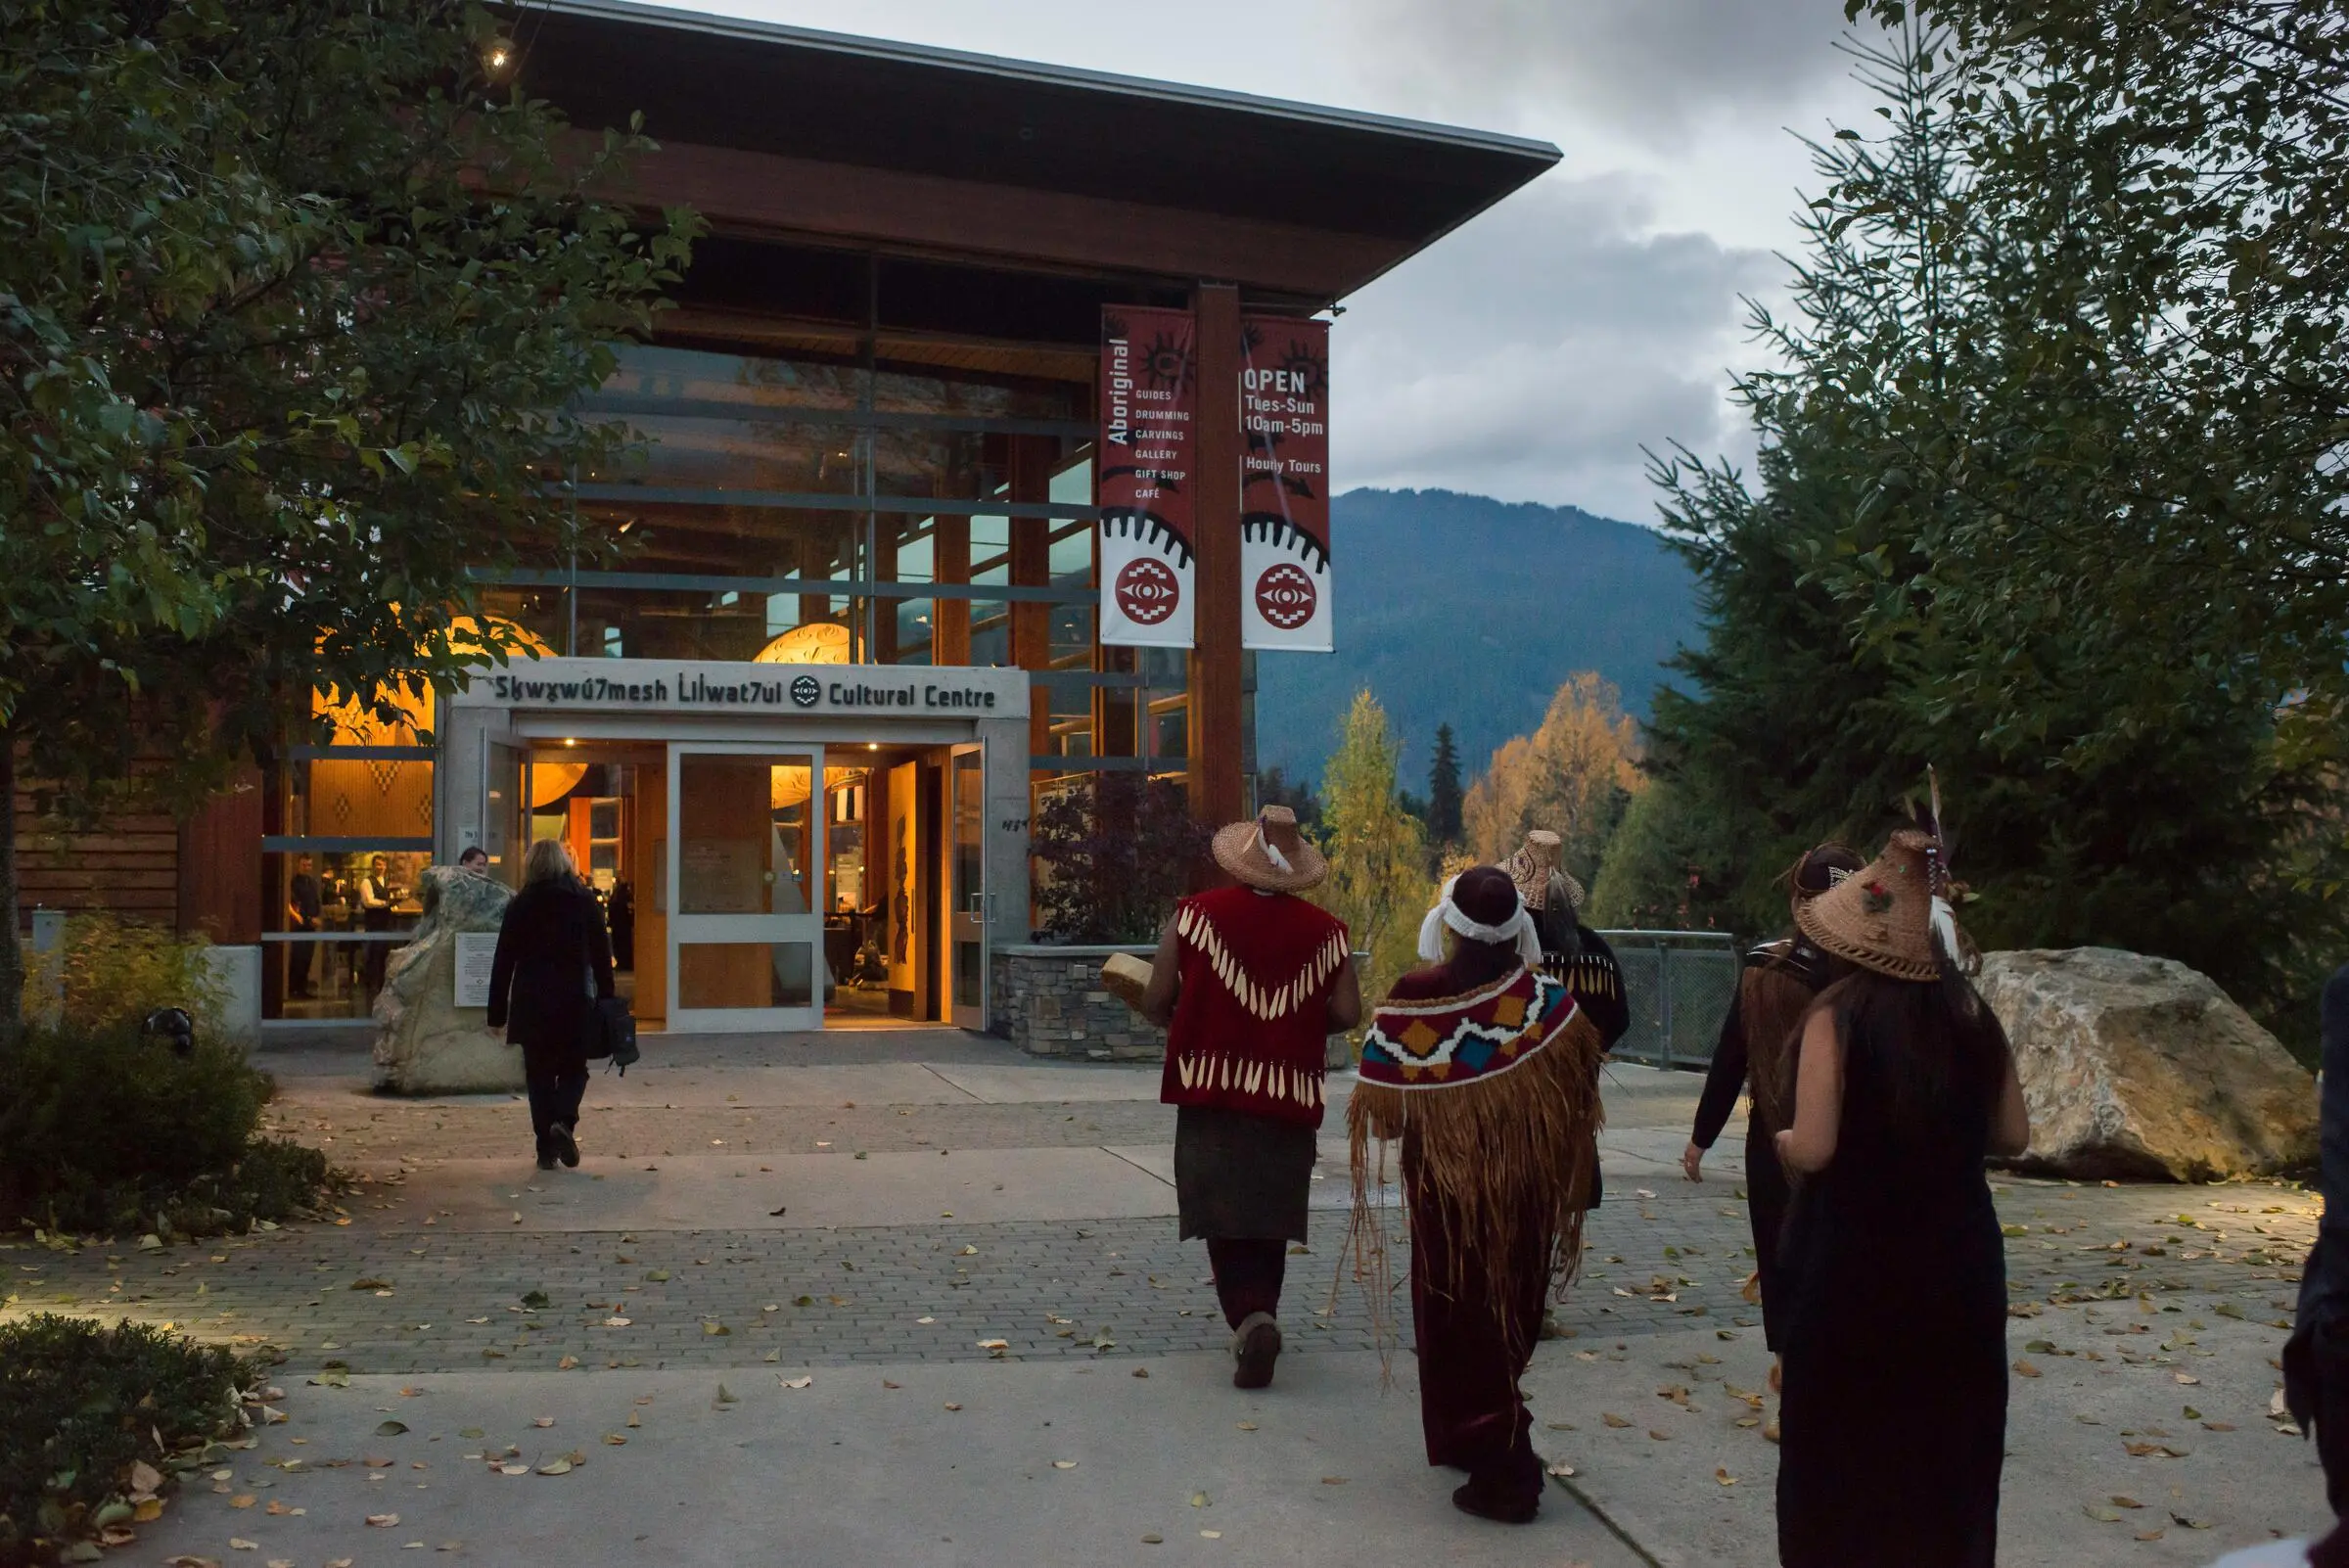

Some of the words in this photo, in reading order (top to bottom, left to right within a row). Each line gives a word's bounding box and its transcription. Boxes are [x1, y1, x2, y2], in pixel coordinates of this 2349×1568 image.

[1244, 368, 1305, 393] OPEN
[1108, 339, 1133, 446] Aboriginal
[1135, 390, 1172, 400] GUIDES
[1245, 394, 1314, 415] Tues-Sun
[1135, 409, 1189, 421] DRUMMING
[1245, 415, 1323, 437] 10am-5pm
[1135, 429, 1184, 440] CARVINGS
[1135, 449, 1177, 460] GALLERY
[1288, 459, 1321, 474] Tours
[1135, 469, 1157, 479] GIFT
[1160, 470, 1186, 481] SHOP
[1135, 486, 1160, 498] CAFÉ
[829, 682, 915, 707] Cultural
[925, 685, 995, 708] Centre
